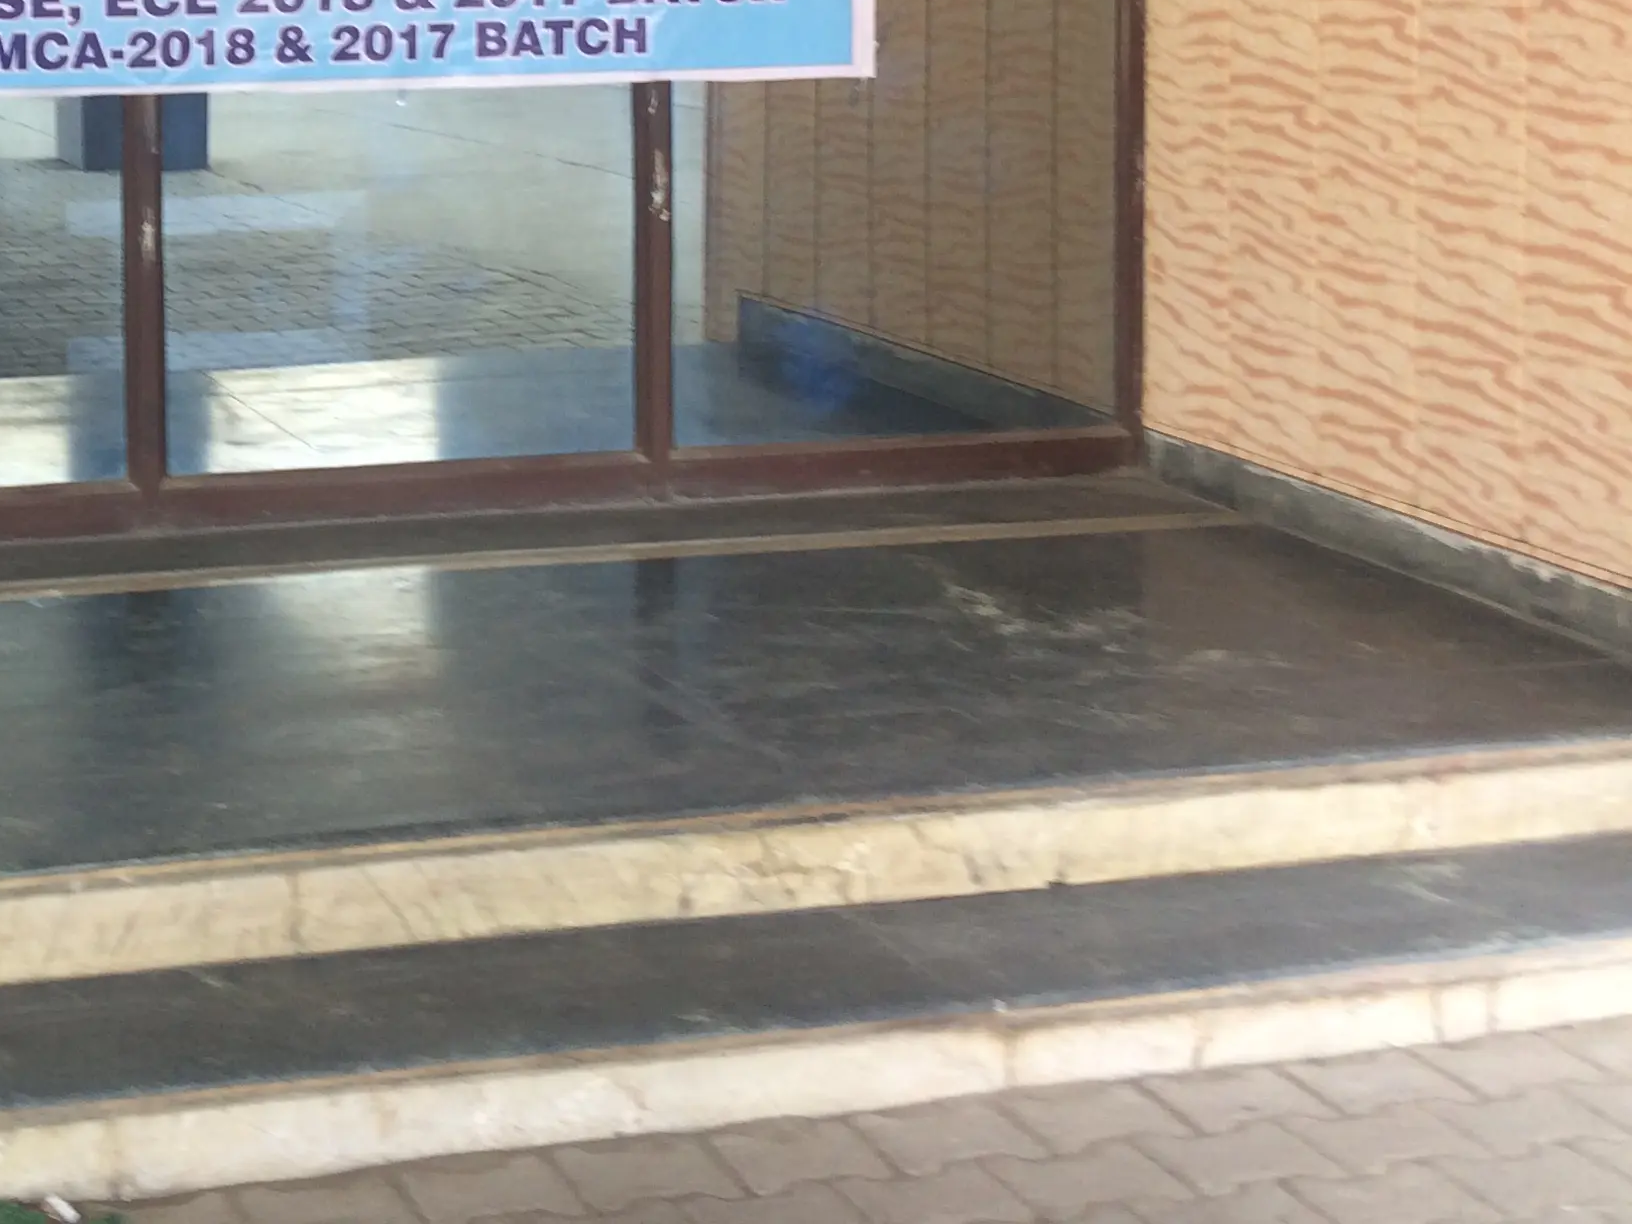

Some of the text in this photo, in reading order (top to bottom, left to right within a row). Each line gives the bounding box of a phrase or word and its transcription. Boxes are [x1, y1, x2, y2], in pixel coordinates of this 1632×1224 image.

[276, 23, 314, 64] &
[331, 22, 456, 62] 2017
[476, 17, 648, 57] BATCH
